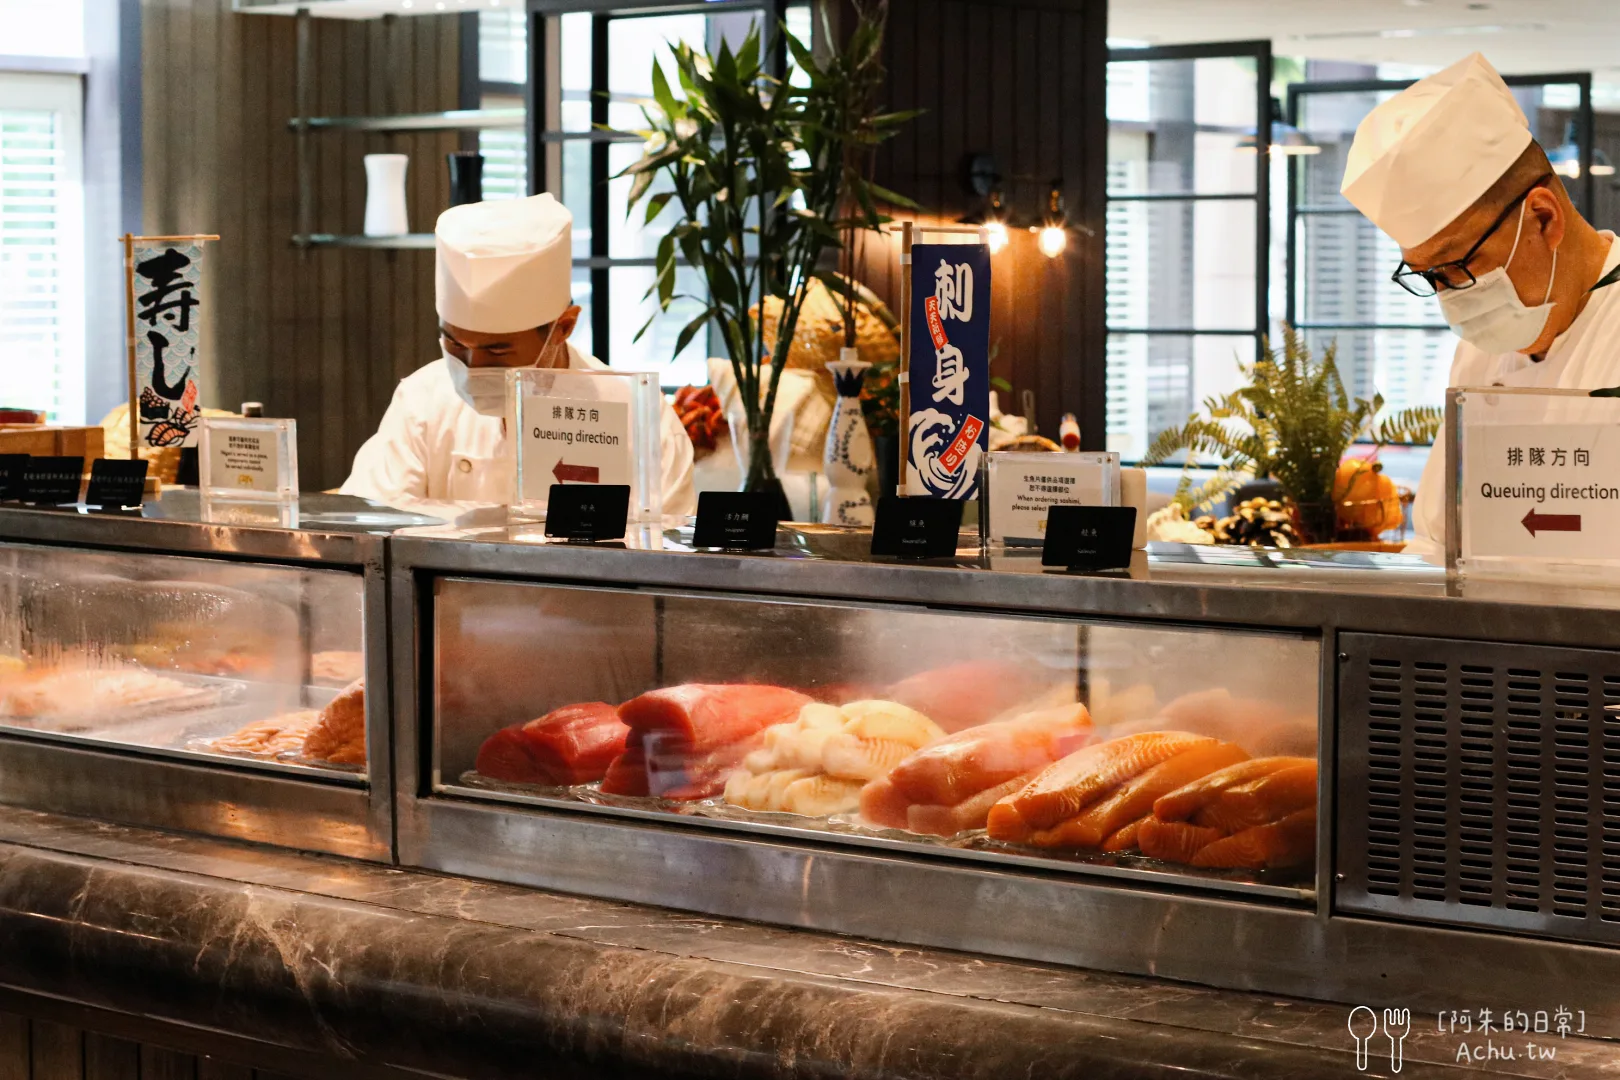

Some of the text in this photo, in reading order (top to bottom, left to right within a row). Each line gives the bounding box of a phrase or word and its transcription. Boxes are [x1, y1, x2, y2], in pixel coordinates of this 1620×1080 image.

[135, 248, 200, 400] 寿し
[932, 259, 974, 406] 刺身
[552, 405, 600, 423] 排隊方向
[533, 427, 619, 446] Queuing direction
[1507, 447, 1590, 467] 排隊方向
[1034, 496, 1058, 504] ordering
[1481, 483, 1620, 503] Queuing direction
